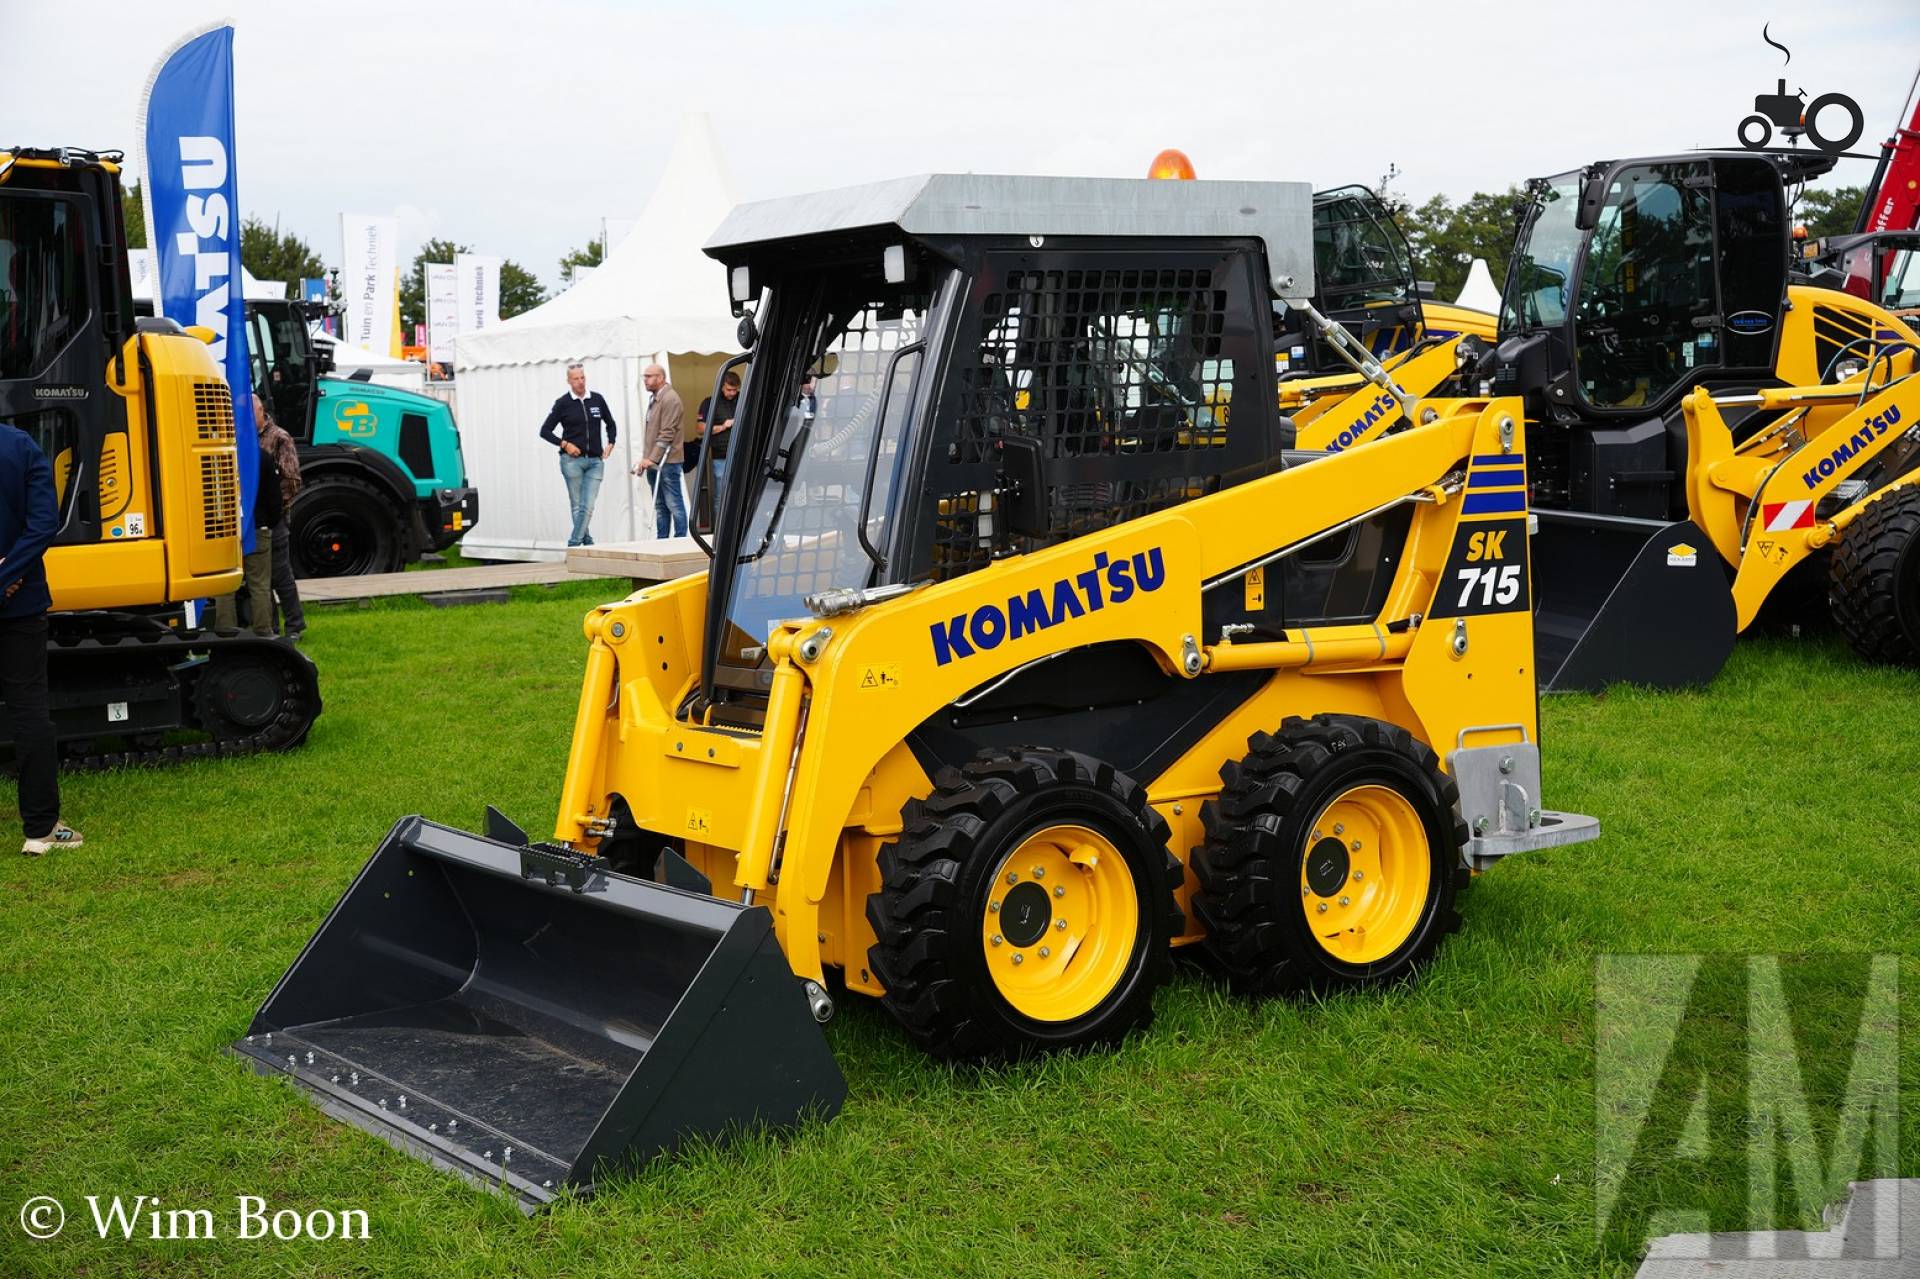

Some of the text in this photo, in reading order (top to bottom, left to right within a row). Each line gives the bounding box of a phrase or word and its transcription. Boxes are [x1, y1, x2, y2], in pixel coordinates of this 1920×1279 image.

[360, 225, 377, 341] Tuin en Park Techniek
[35, 386, 85, 397] KOMATSU
[1802, 404, 1901, 490] KOMATSU
[1466, 530, 1508, 562] SK
[930, 547, 1165, 667] KOMATSU
[1457, 565, 1521, 608] 715
